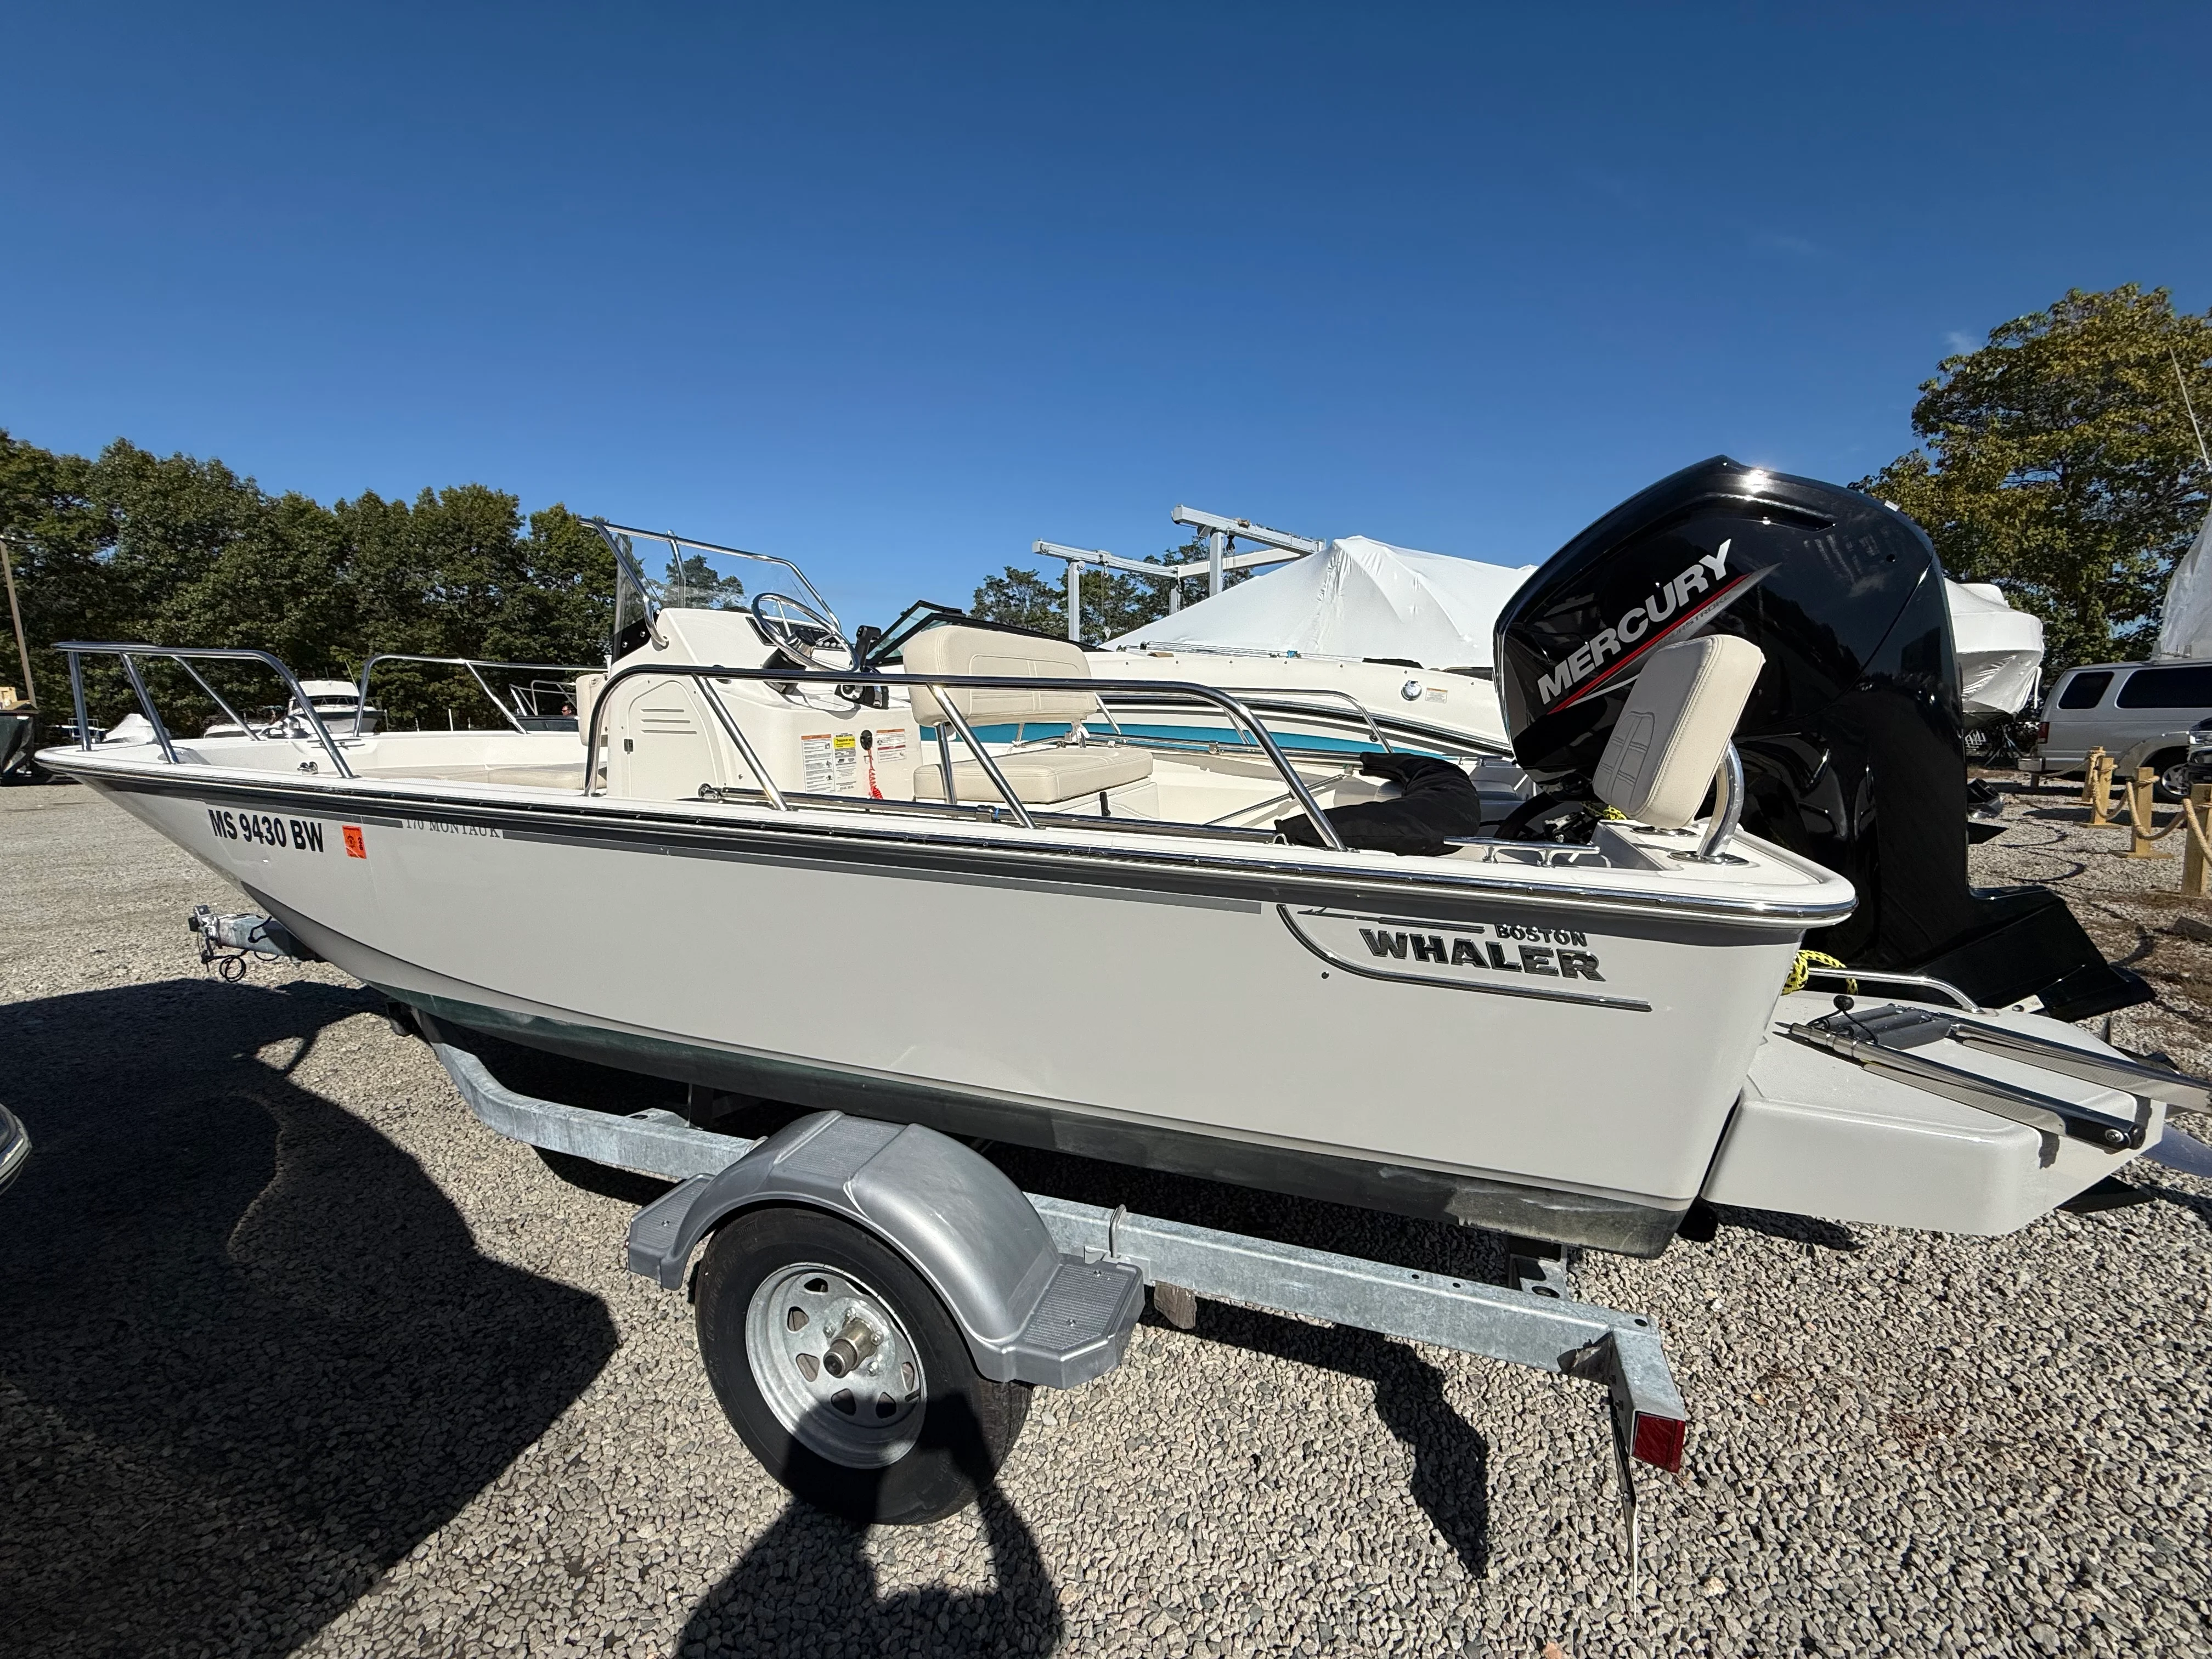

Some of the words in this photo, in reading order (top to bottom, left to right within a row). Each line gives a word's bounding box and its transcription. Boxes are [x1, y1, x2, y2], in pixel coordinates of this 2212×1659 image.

[1537, 539, 1731, 704] MERCURY
[207, 809, 238, 840] MS
[239, 813, 287, 848] 9430
[289, 819, 324, 853] BW
[1358, 928, 1607, 982] WHALER
[1494, 924, 1588, 947] BOSTON
